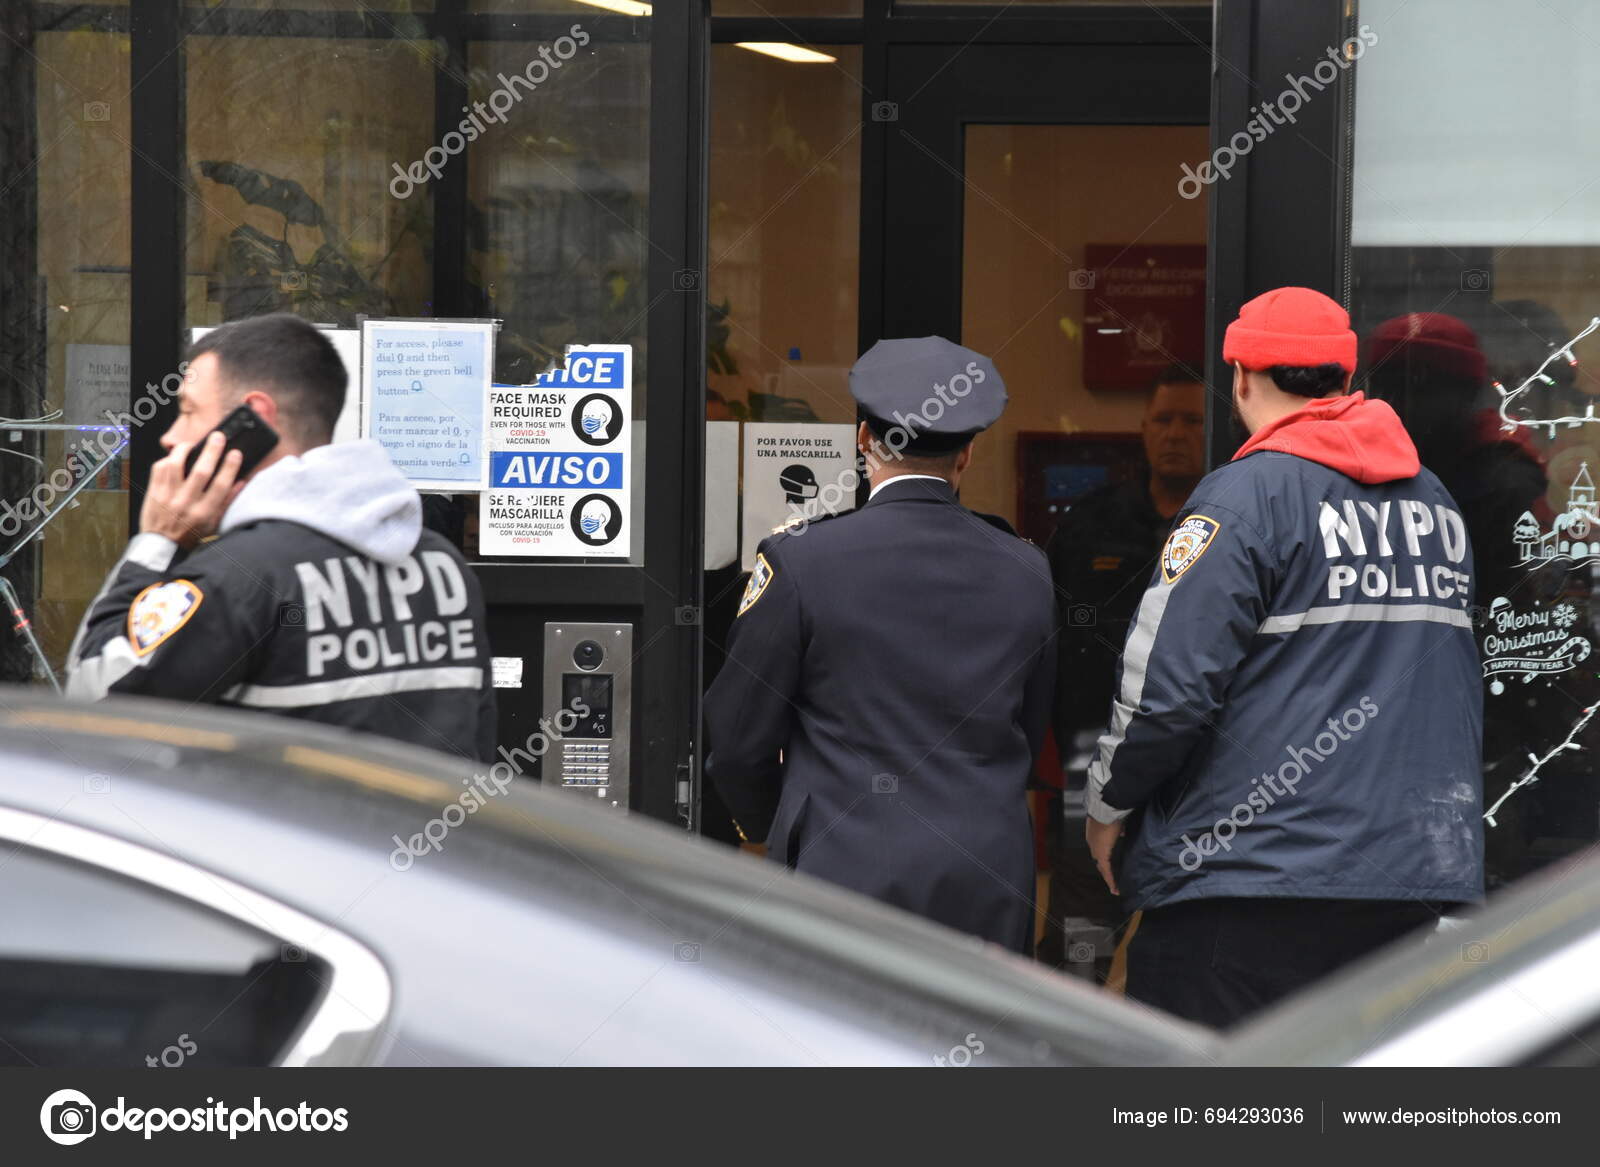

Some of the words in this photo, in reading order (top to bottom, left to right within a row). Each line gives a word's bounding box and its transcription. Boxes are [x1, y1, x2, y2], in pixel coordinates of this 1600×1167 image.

[376, 339, 393, 348] For
[396, 341, 429, 350] access,
[432, 338, 463, 349] please
[376, 353, 394, 362] dial
[406, 353, 424, 362] and
[427, 352, 450, 362] then
[377, 367, 402, 377] press
[405, 366, 420, 376] the
[423, 368, 451, 378] green
[454, 366, 472, 376] bell
[377, 386, 409, 396] button
[490, 393, 522, 404] FACE
[528, 393, 566, 405] MASK
[493, 406, 562, 419] REQUIRED
[379, 413, 401, 422] Para
[403, 415, 436, 424] acceso,
[439, 415, 456, 425] por
[490, 421, 508, 429] EVEN
[509, 421, 522, 429] FOR
[525, 421, 546, 429] THOSE
[548, 421, 566, 429] WITH
[378, 426, 401, 436] favor
[405, 427, 439, 436] marcar
[441, 427, 450, 436] el
[464, 428, 472, 438] y
[510, 429, 546, 437] COVID-19
[406, 439, 415, 449] el
[416, 440, 442, 450] signo
[444, 440, 456, 449] de
[459, 440, 468, 449] la
[506, 437, 550, 445] VACCINATION
[757, 438, 777, 446] POR
[779, 438, 812, 447] FAVOR
[814, 438, 832, 447] USE
[757, 449, 777, 458] UNA
[779, 450, 841, 459] MASCARILLA
[431, 458, 457, 468] verde
[501, 456, 610, 485] AVISO
[489, 494, 503, 506] SE
[489, 508, 564, 520] MASCARILLA
[488, 522, 515, 530] INCLUSO
[515, 522, 533, 530] PARA
[533, 522, 565, 531] AQUELLOS
[1318, 499, 1466, 564] NYPD
[512, 537, 541, 545] COVID-19
[294, 551, 468, 632] NYPD
[1496, 610, 1549, 633] Merry
[307, 618, 477, 677] POLICE
[1484, 628, 1569, 656] Christmas
[1490, 660, 1519, 670] HAPPY
[1520, 660, 1540, 670] NEW
[1540, 660, 1564, 670] YEAR
